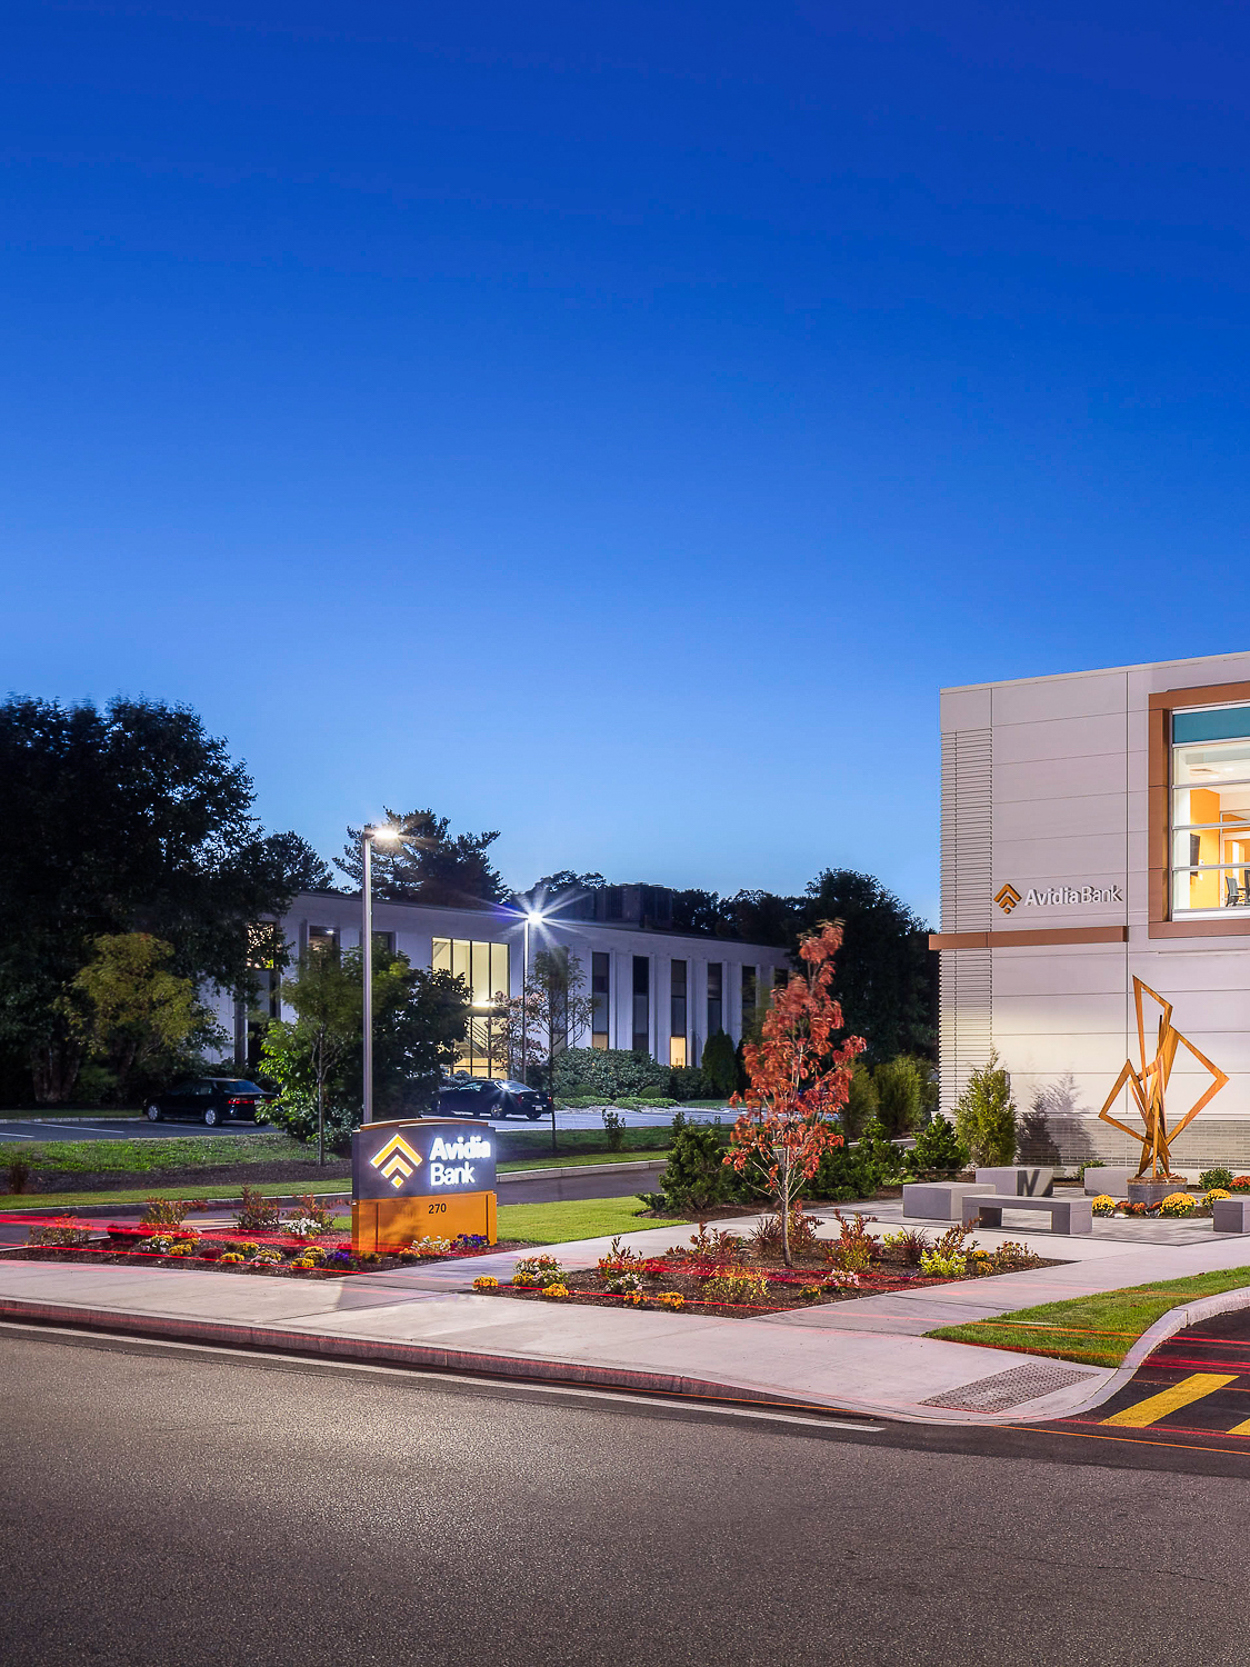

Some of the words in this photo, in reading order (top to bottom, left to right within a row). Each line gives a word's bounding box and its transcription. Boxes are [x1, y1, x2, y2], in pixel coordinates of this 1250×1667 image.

[429, 1136, 491, 1161] Avidia
[430, 1161, 475, 1186] Bank
[428, 1203, 446, 1214] 270
